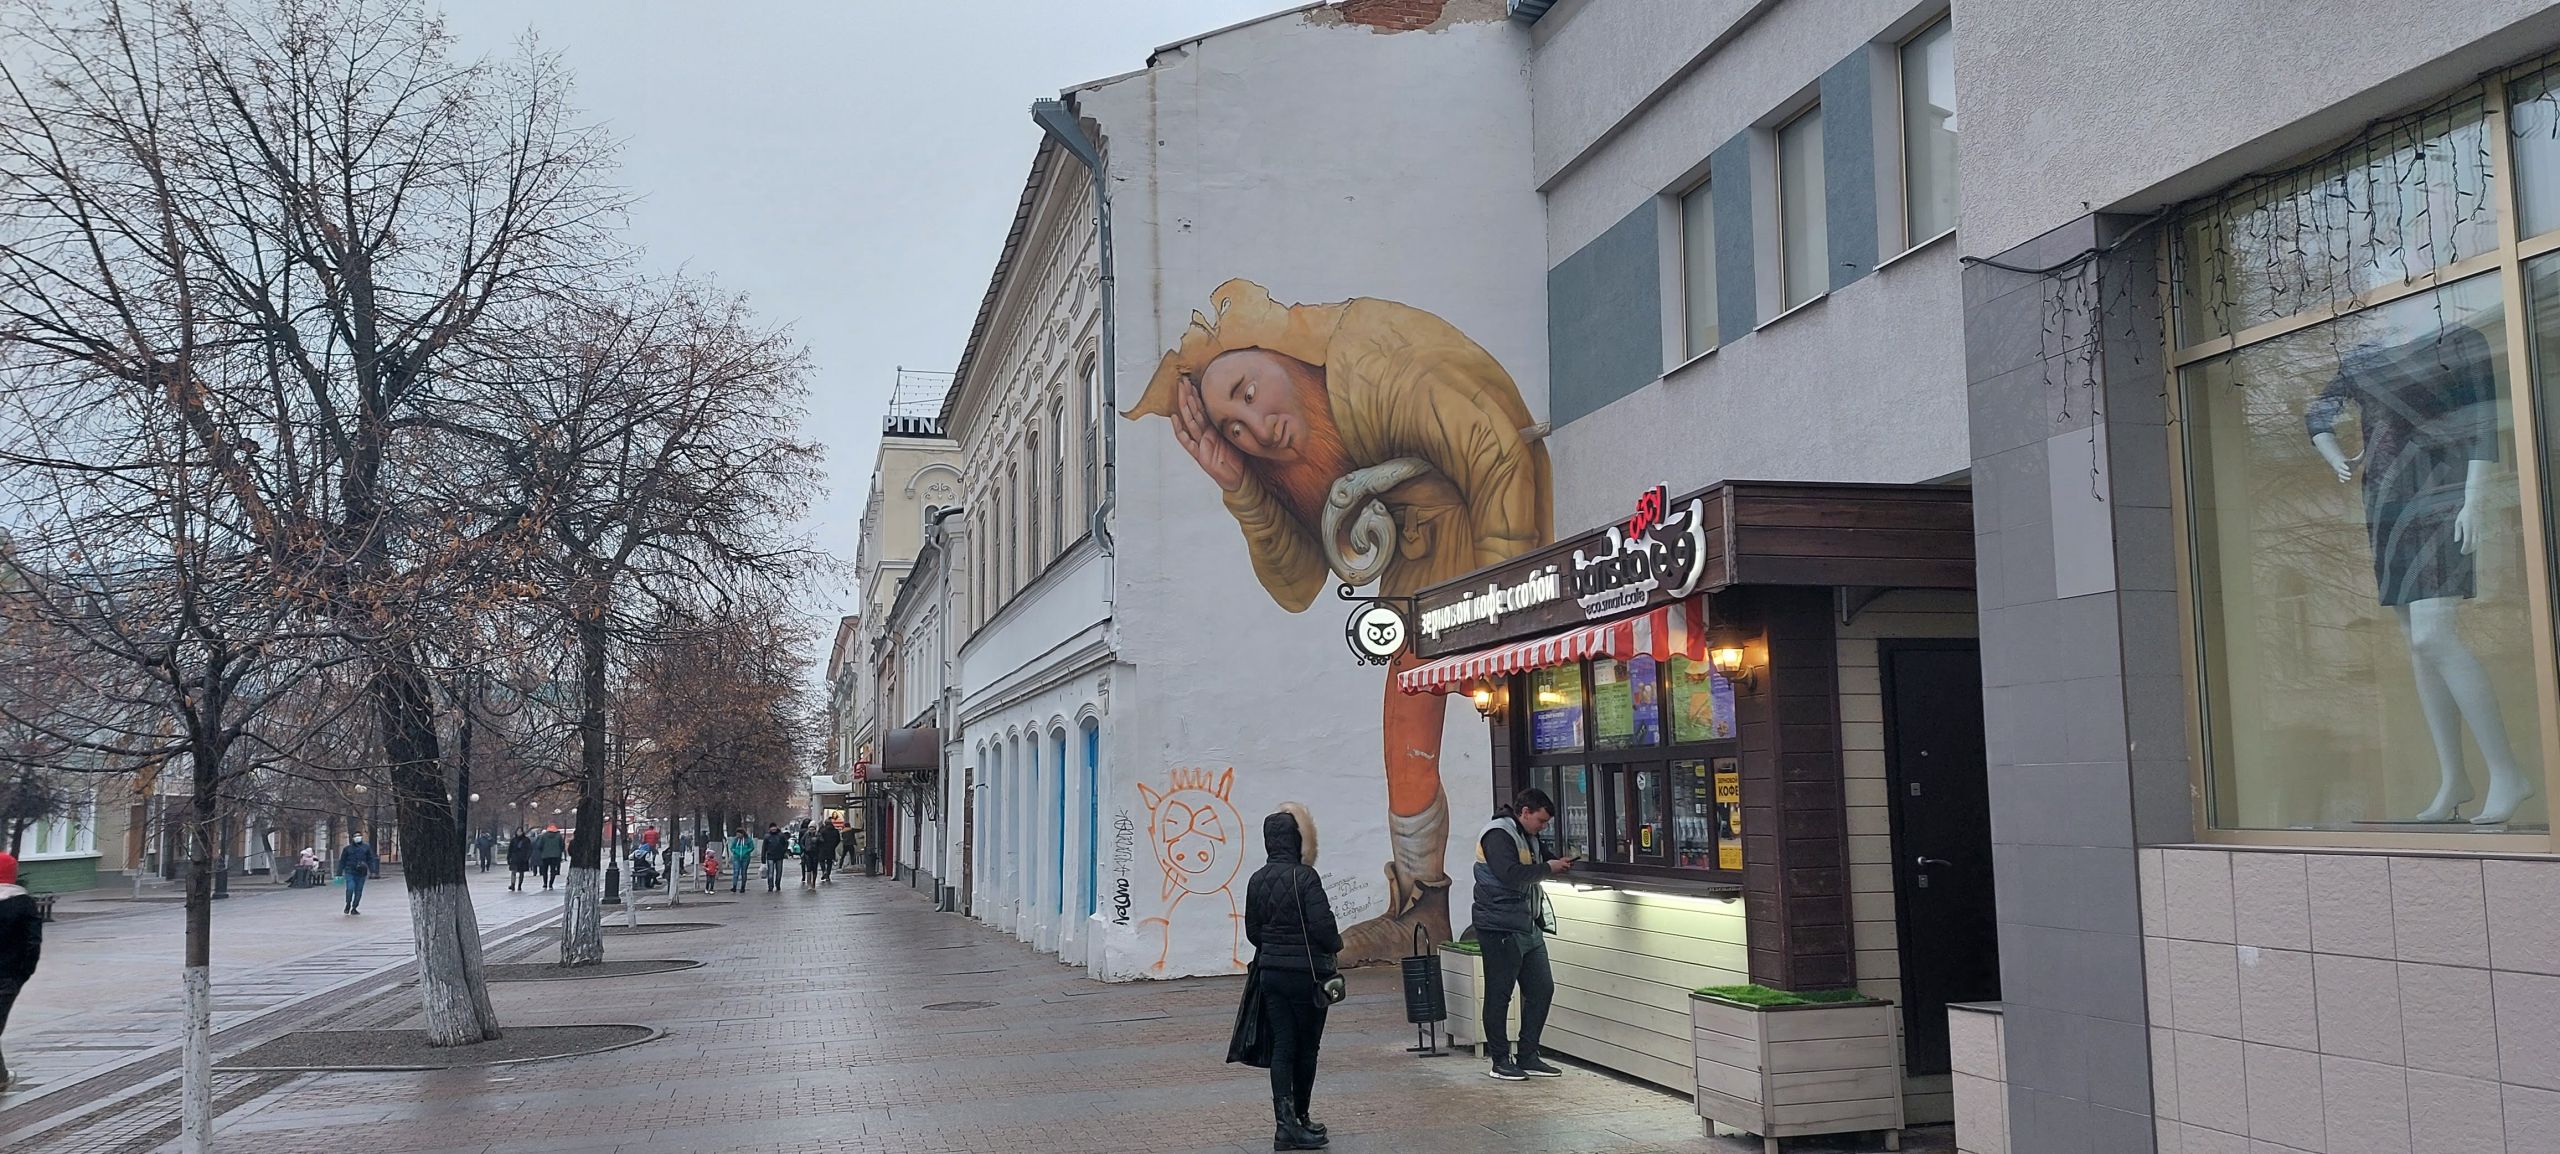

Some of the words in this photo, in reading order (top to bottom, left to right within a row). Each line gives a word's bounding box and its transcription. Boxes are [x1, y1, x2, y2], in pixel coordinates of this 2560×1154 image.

[1629, 485, 1664, 540] city
[1570, 535, 1651, 599] barista
[1421, 592, 1474, 640] зерновой
[1473, 584, 1507, 625] кофе
[1515, 565, 1561, 608] собой
[1586, 587, 1645, 615] eco.smart.cafe
[1718, 785, 1739, 797] КОФЕ
